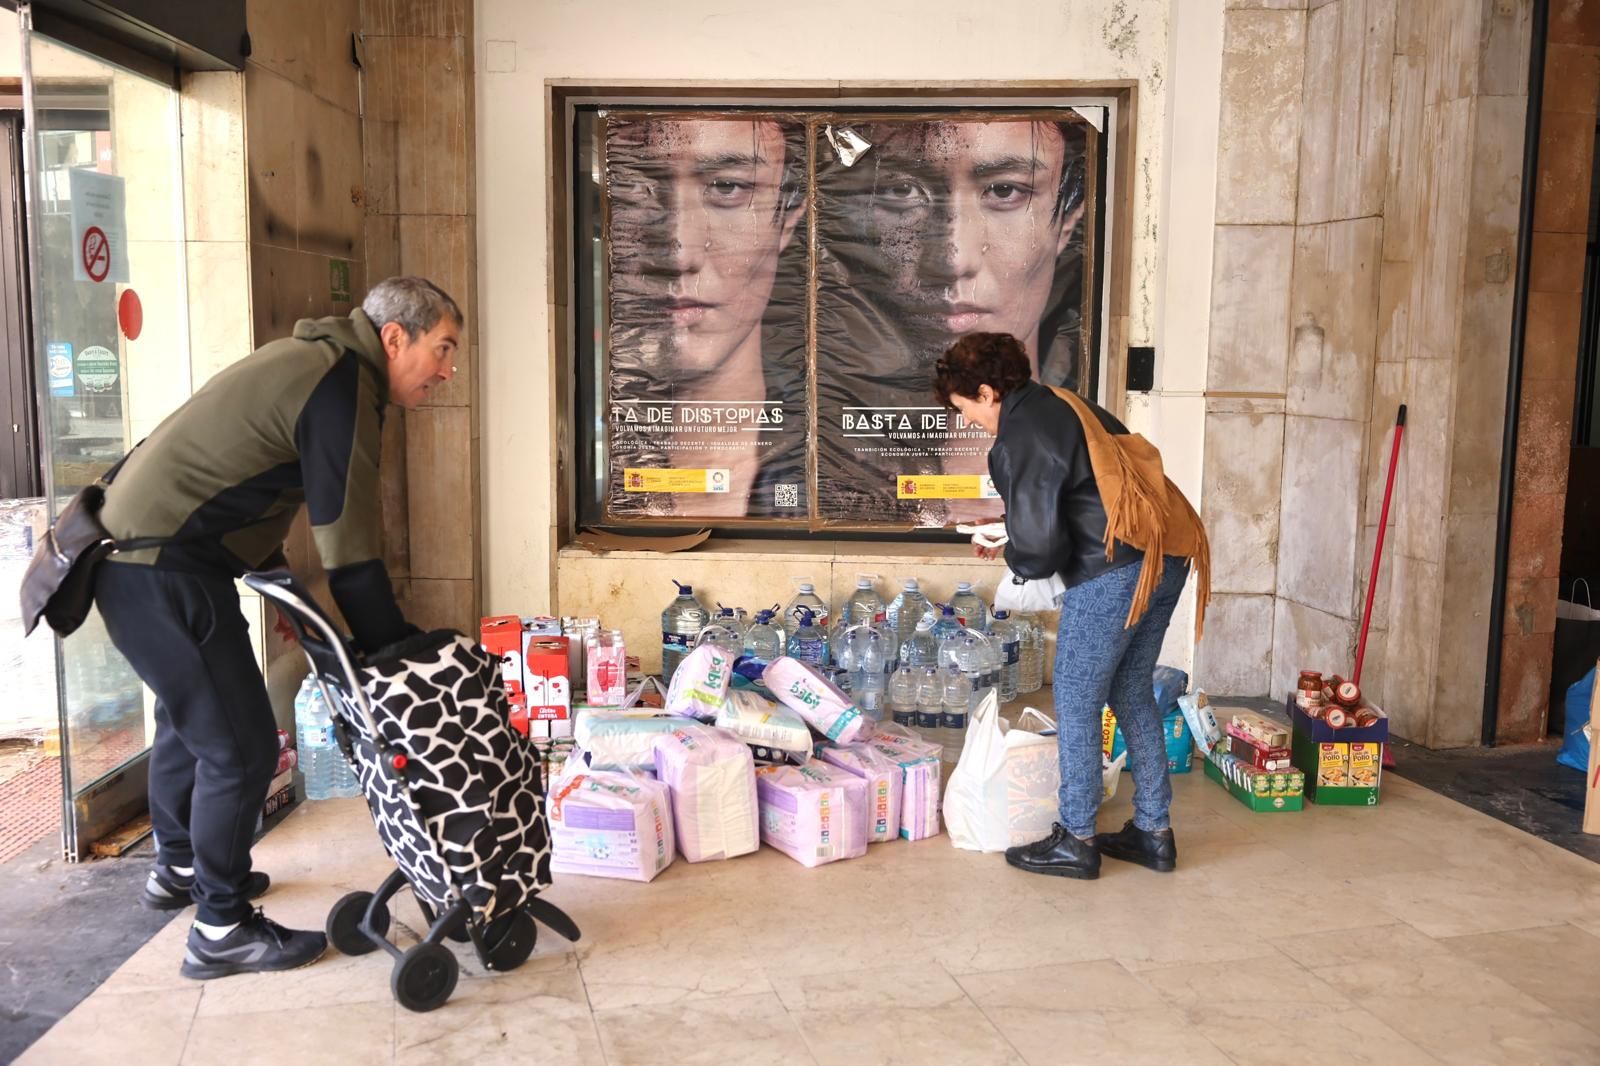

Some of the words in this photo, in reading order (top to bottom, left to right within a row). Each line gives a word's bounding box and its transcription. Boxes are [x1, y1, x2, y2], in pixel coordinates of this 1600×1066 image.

[611, 407, 638, 423] TA
[647, 407, 673, 423] DE
[681, 407, 784, 424] DISTOPIAS
[842, 413, 913, 430] BASTA
[921, 413, 947, 430] DE
[615, 425, 646, 433] VOLVAMOS
[652, 425, 683, 433] IMAGINAR
[684, 425, 692, 433] UN
[693, 425, 717, 433] FUTURO
[717, 425, 738, 433] MEJOR
[958, 431, 967, 439] UN
